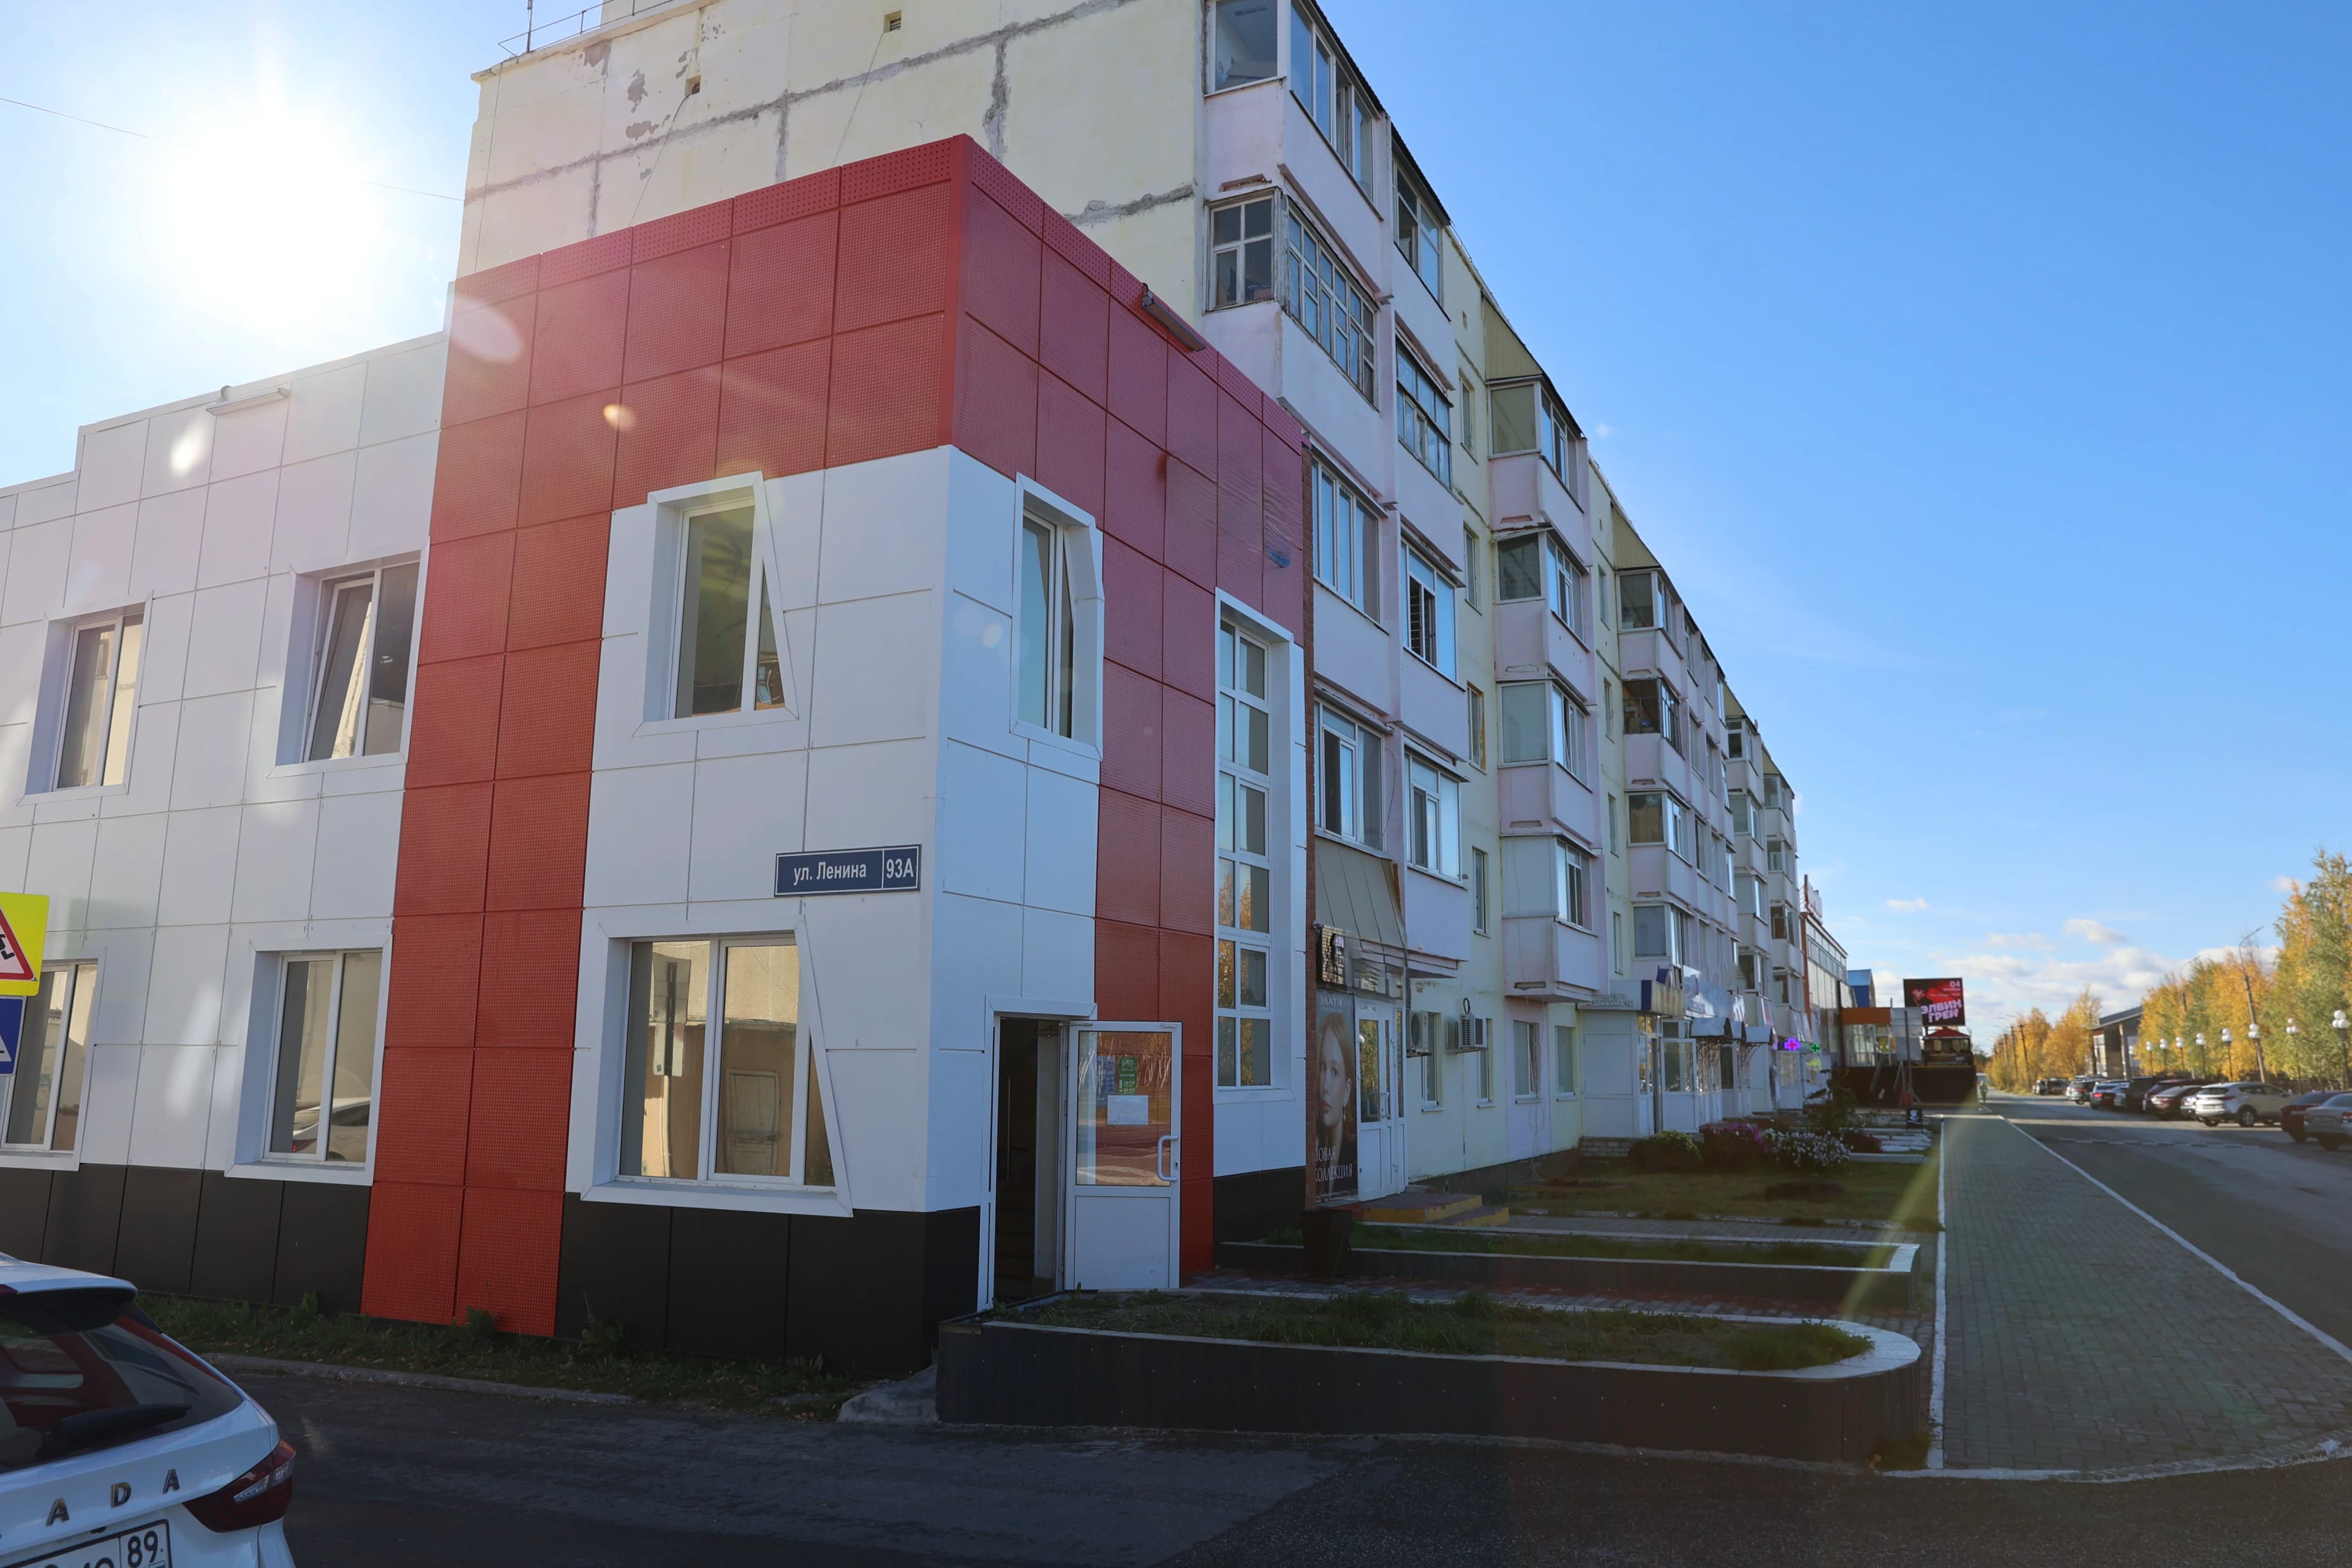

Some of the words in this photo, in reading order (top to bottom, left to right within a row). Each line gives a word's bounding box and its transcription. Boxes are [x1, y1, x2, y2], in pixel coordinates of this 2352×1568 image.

[793, 867, 813, 886] ул.
[816, 861, 867, 880] Ленина
[886, 858, 914, 878] 93А
[1921, 999, 1962, 1014] ЭЛВИН
[0, 1469, 180, 1539] ADA
[127, 1531, 158, 1568] 89
